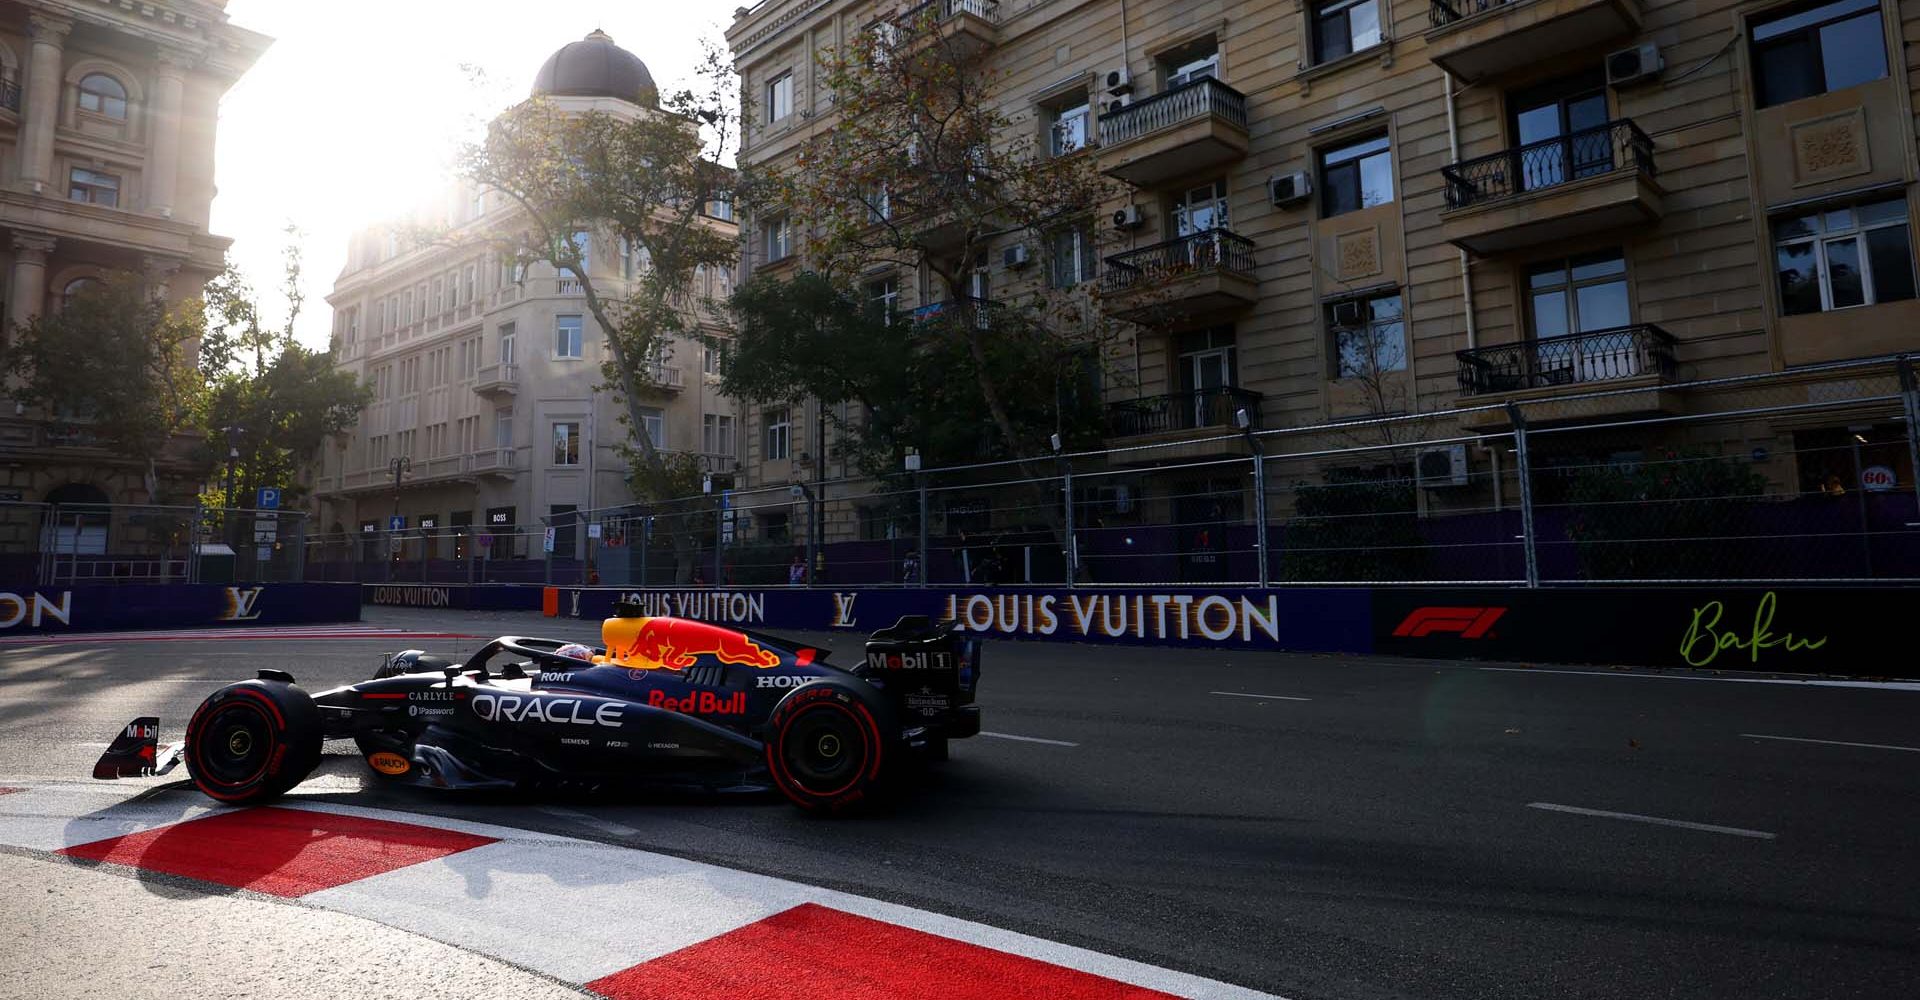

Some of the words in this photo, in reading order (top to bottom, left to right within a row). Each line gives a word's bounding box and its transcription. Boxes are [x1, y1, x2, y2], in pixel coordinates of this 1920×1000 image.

[263, 490, 276, 506] P
[421, 519, 434, 529] BOSS
[493, 513, 507, 523] BOSS
[375, 586, 401, 604] LOUIS
[403, 587, 449, 606] VUITTON
[675, 592, 765, 622] VUITTON
[949, 594, 1059, 635] LOUIS
[1070, 595, 1279, 642] VUITTON
[1680, 592, 1827, 666] Baku
[868, 653, 928, 669] Mobil
[540, 672, 575, 682] ROKT
[756, 675, 822, 688] HON
[408, 691, 455, 701] CARLYLE
[648, 689, 696, 713] Red
[699, 691, 746, 715] Bull
[472, 695, 629, 727] ORACLE
[126, 724, 159, 738] Mobil
[560, 738, 590, 746] SIEMENS
